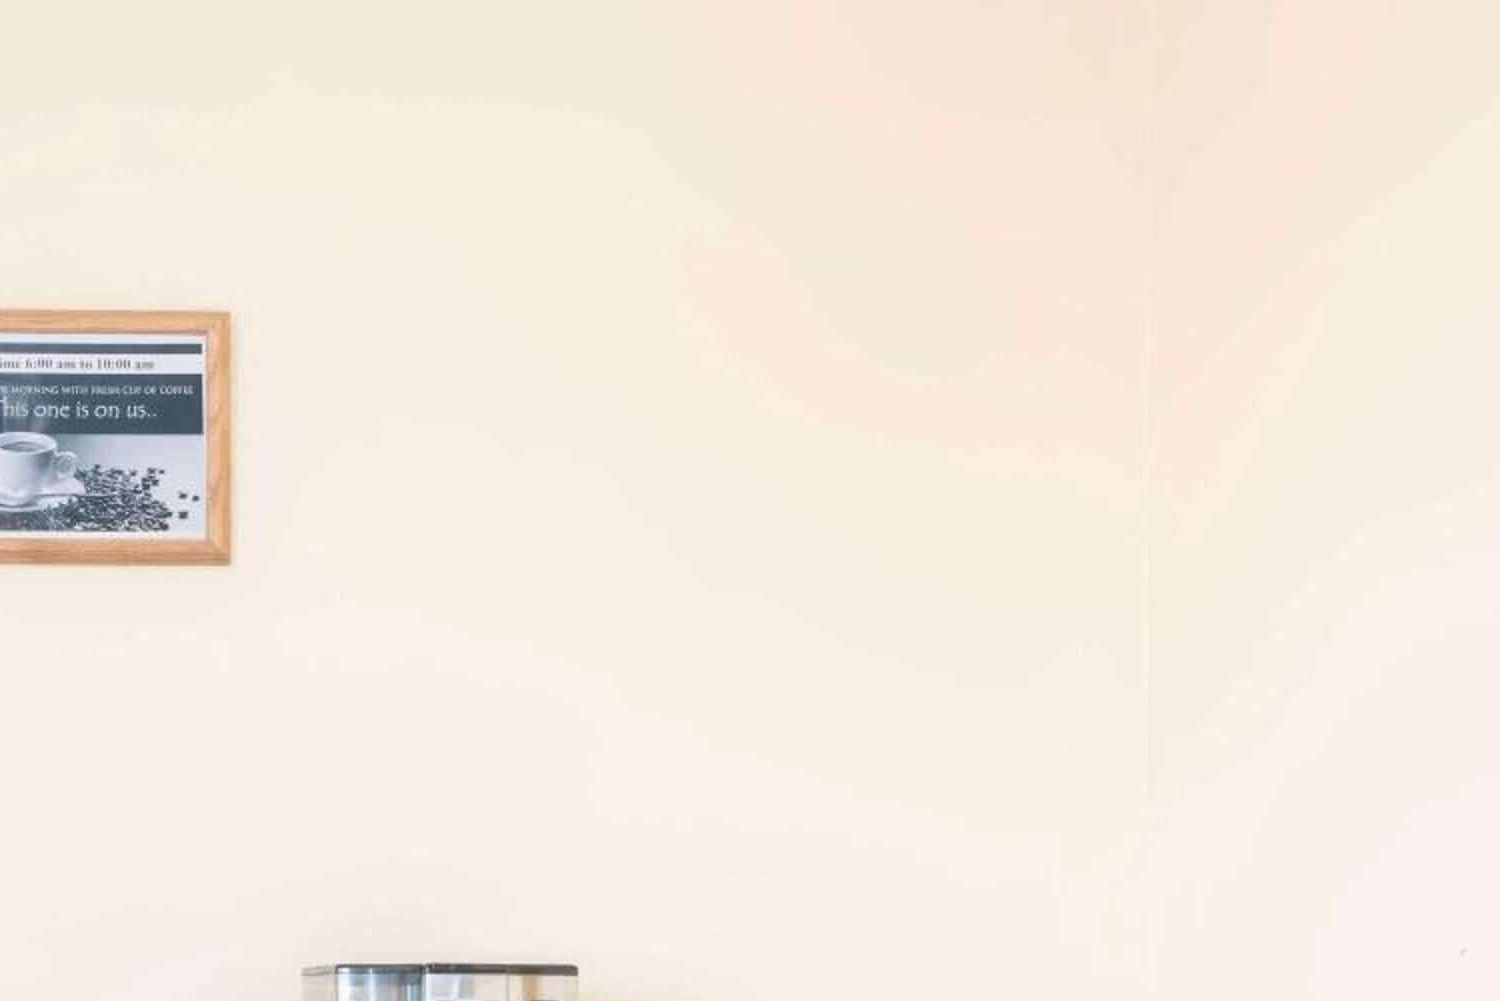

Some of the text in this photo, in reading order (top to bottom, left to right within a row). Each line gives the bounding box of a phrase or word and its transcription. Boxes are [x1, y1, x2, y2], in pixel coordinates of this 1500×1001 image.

[25, 358, 52, 369] 6:00
[56, 361, 76, 369] am
[79, 360, 93, 369] to
[96, 358, 131, 369] 10:00
[134, 361, 155, 369] am
[61, 384, 88, 395] WITH
[34, 404, 70, 419] one
[75, 401, 89, 418] is
[93, 404, 120, 419] on
